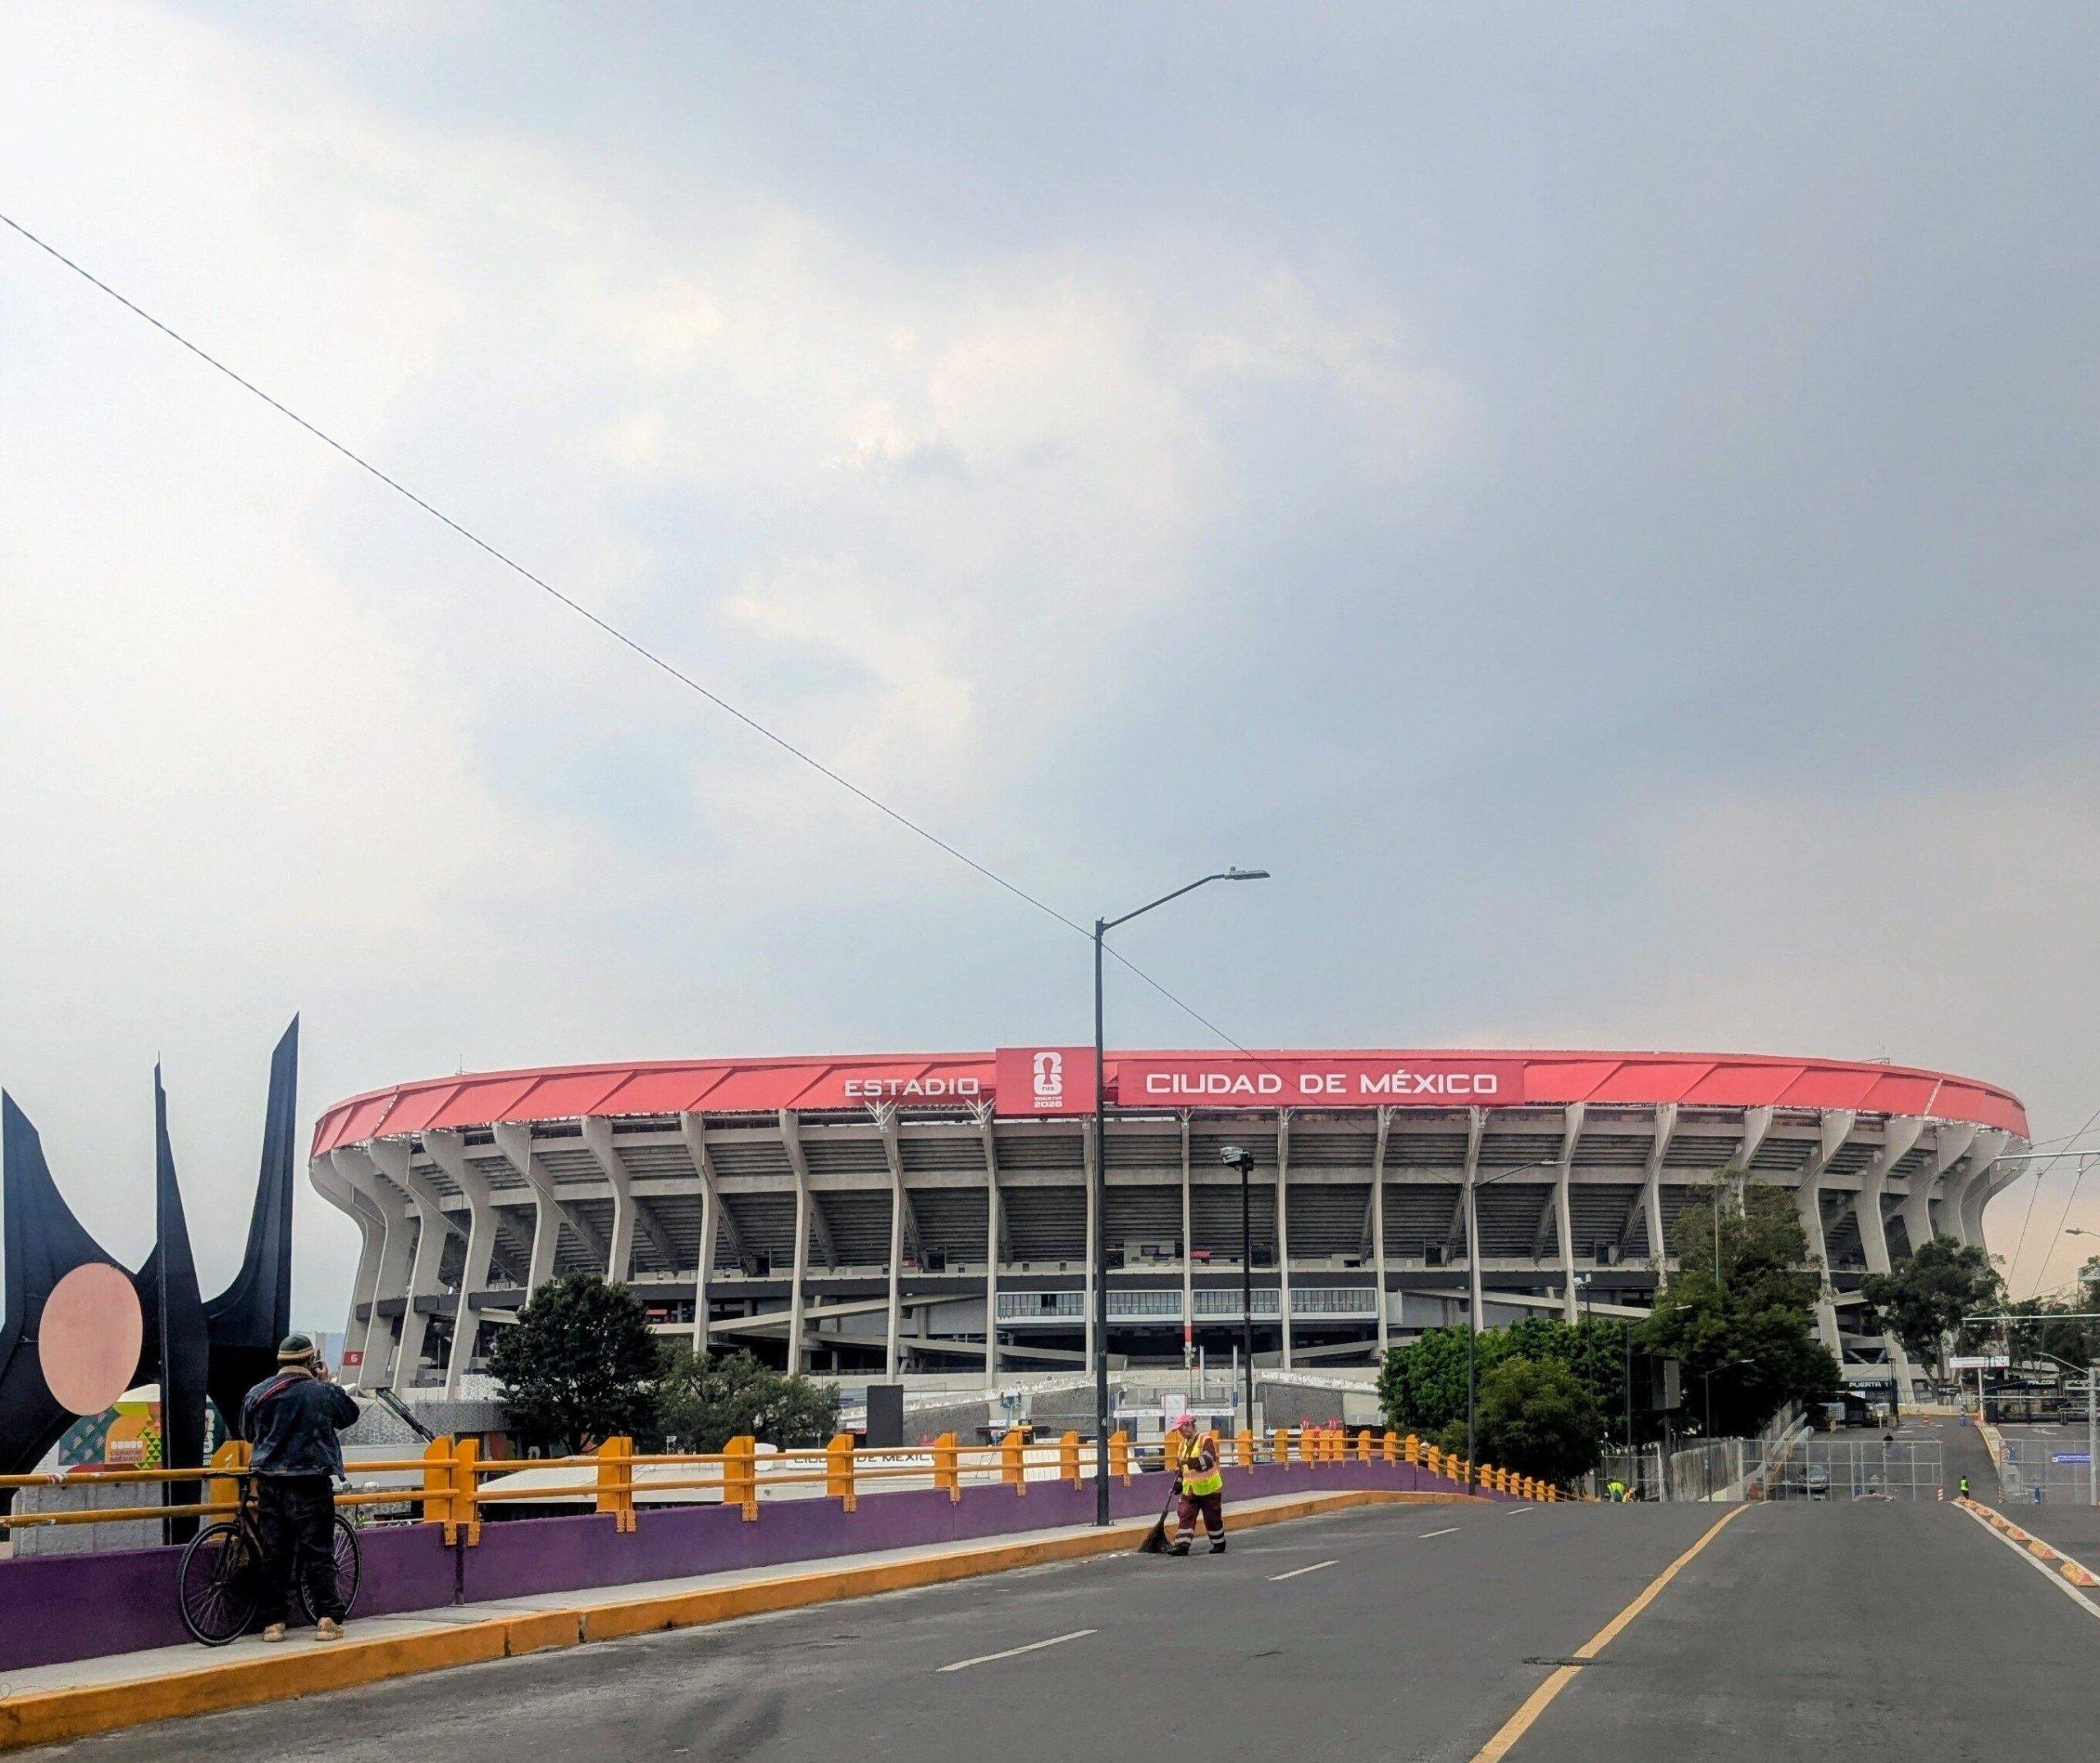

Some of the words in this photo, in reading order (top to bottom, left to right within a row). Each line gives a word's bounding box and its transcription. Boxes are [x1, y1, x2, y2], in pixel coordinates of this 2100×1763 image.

[844, 1077, 979, 1097] ESTADIO
[1146, 1073, 1283, 1094] CIUDAD
[1299, 1073, 1347, 1094] DE
[1360, 1069, 1498, 1094] MÉXICO
[1034, 1100, 1063, 1108] 2026
[350, 1354, 358, 1363] 6
